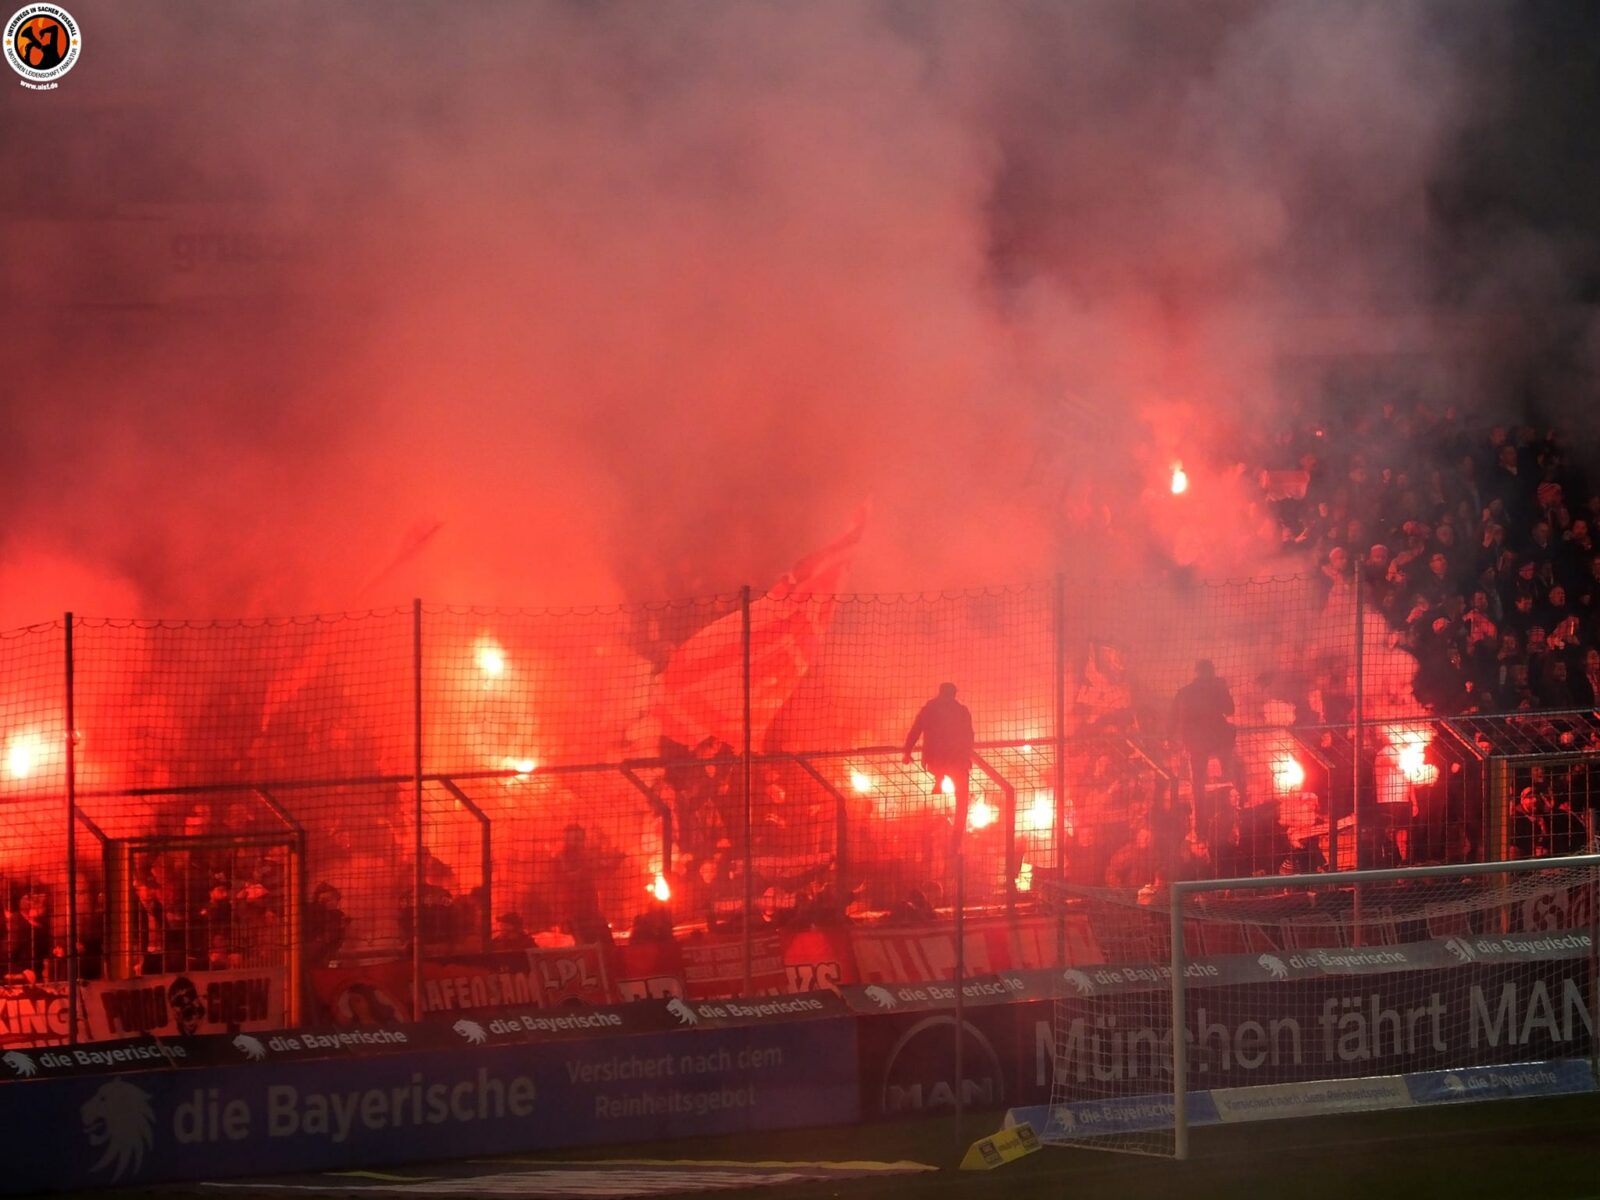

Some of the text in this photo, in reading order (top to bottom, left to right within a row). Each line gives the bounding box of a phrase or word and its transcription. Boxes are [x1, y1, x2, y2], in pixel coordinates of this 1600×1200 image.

[1476, 934, 1592, 954] die Bayerische
[1289, 951, 1407, 969] die Bayerische
[1095, 970, 1123, 985] die
[898, 988, 928, 1002] die
[698, 998, 823, 1018] die Bayerische
[489, 1012, 622, 1034] die Bayerische
[1318, 992, 1448, 1062] fährt
[268, 1029, 408, 1052] die Bayerische
[39, 1052, 73, 1068] die
[73, 1044, 187, 1066] Bayerische
[566, 1046, 783, 1084] Versichert nach dem
[888, 1077, 994, 1108] MAN
[1467, 1076, 1489, 1090] die
[173, 1067, 536, 1143] die Bayerische
[594, 1084, 757, 1120] Reinheitsgebot
